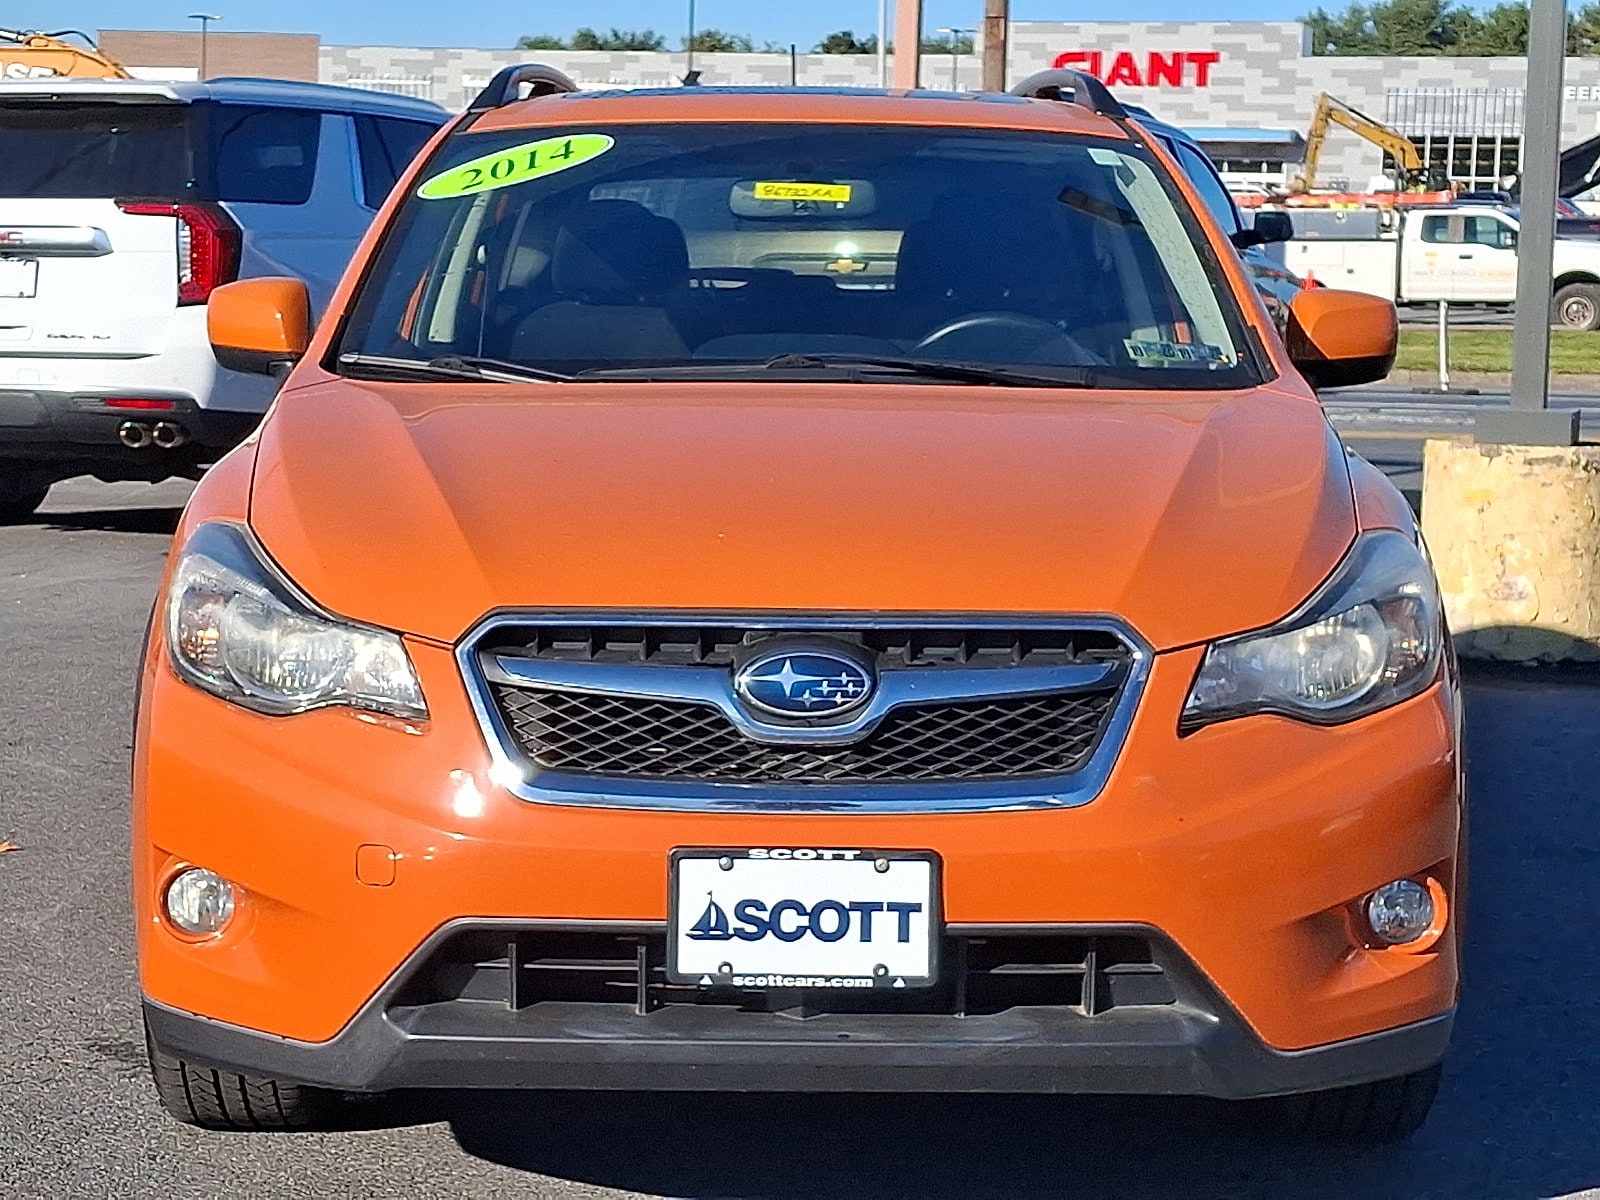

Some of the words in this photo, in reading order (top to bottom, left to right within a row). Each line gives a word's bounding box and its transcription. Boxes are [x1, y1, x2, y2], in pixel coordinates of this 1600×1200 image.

[460, 139, 575, 191] 2014
[748, 848, 862, 860] SCOTT
[732, 898, 923, 943] SCOTT
[731, 974, 874, 988] scottcars.com
